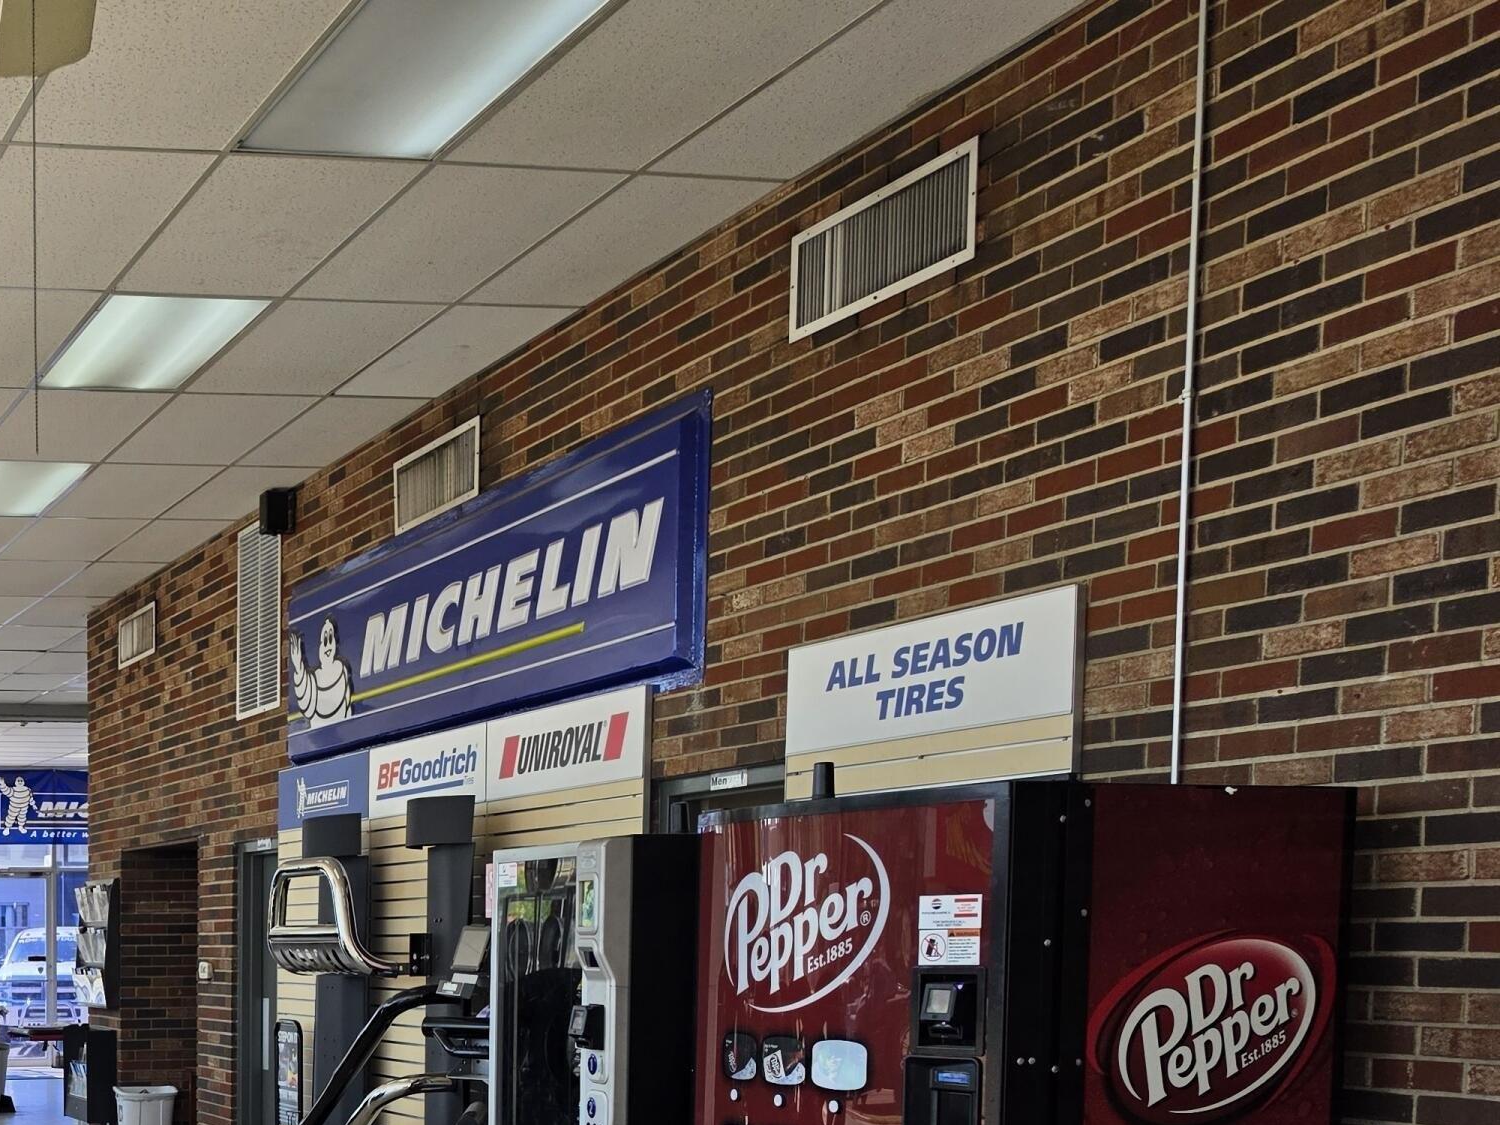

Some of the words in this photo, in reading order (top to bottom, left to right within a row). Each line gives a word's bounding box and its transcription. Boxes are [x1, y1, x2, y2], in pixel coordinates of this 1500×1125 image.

[359, 497, 665, 679] MICHELIN
[826, 653, 880, 692] ALL
[891, 621, 1024, 679] SEASON
[876, 676, 965, 720] TIRES
[377, 744, 477, 790] BFGoodrich
[517, 720, 604, 775] UNIROYAL
[306, 786, 347, 805] MICHELIN
[711, 777, 727, 786] Men
[30, 830, 37, 838] A
[42, 830, 76, 838] better
[770, 851, 828, 927] Dr
[725, 872, 873, 995] Pepper
[1185, 961, 1255, 1036] Dr
[1118, 977, 1300, 1107] Pepper
